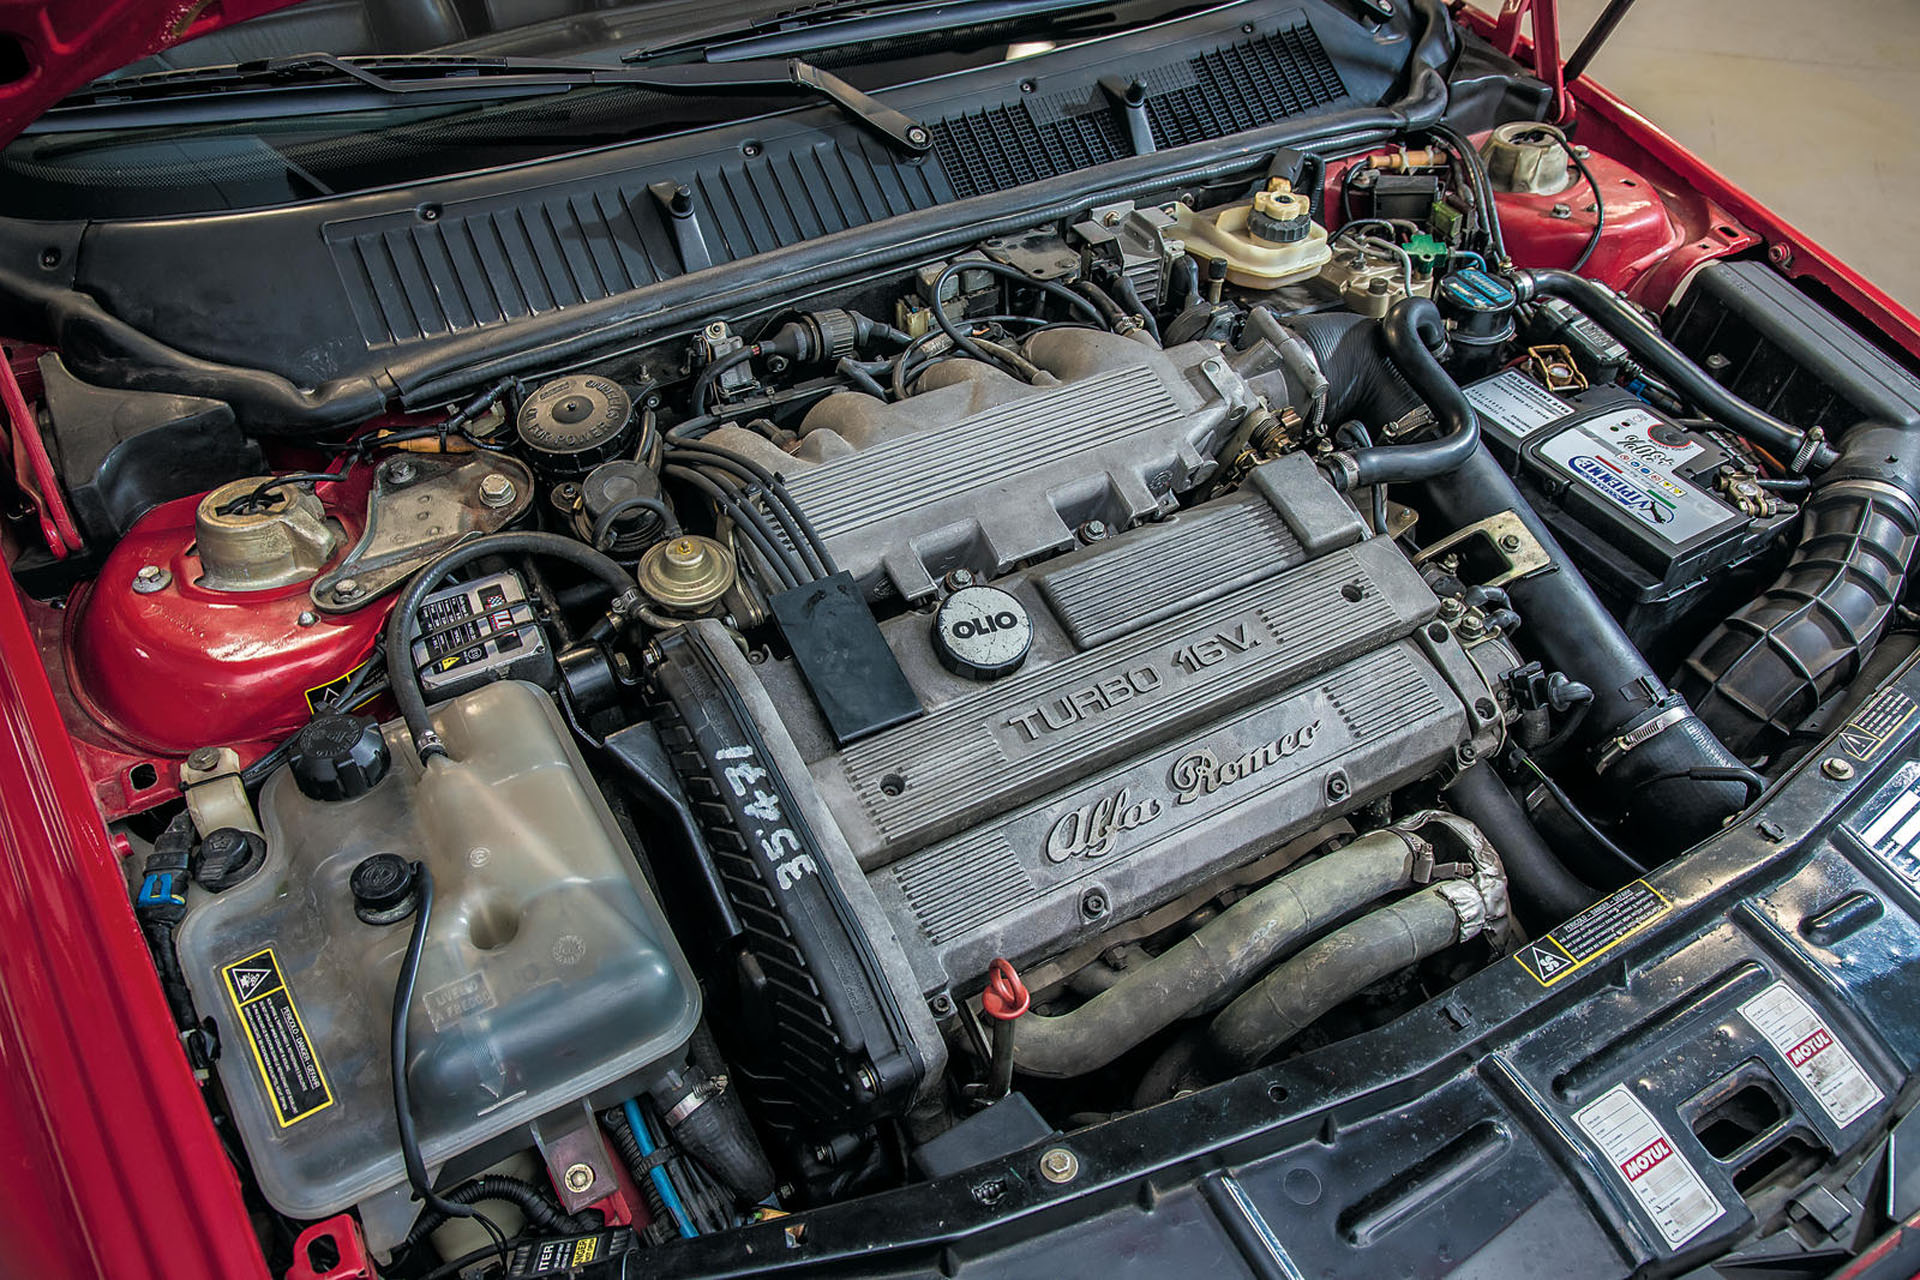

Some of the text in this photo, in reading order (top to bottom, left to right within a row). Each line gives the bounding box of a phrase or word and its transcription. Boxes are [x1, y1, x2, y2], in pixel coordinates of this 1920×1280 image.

[1524, 384, 1552, 402] ENERGY
[554, 421, 611, 445] POWER
[1616, 435, 1675, 466] +30%
[1580, 460, 1649, 508] VIPIEMME
[951, 611, 1018, 639] OLIO
[1006, 663, 1163, 740] TURBO
[1044, 719, 1324, 865] Alfa Romeo
[283, 1006, 321, 1089] PERICOLO DANGER GEFAHR
[1789, 1033, 1831, 1067] MOTUL
[1627, 1144, 1671, 1180] MOTUL
